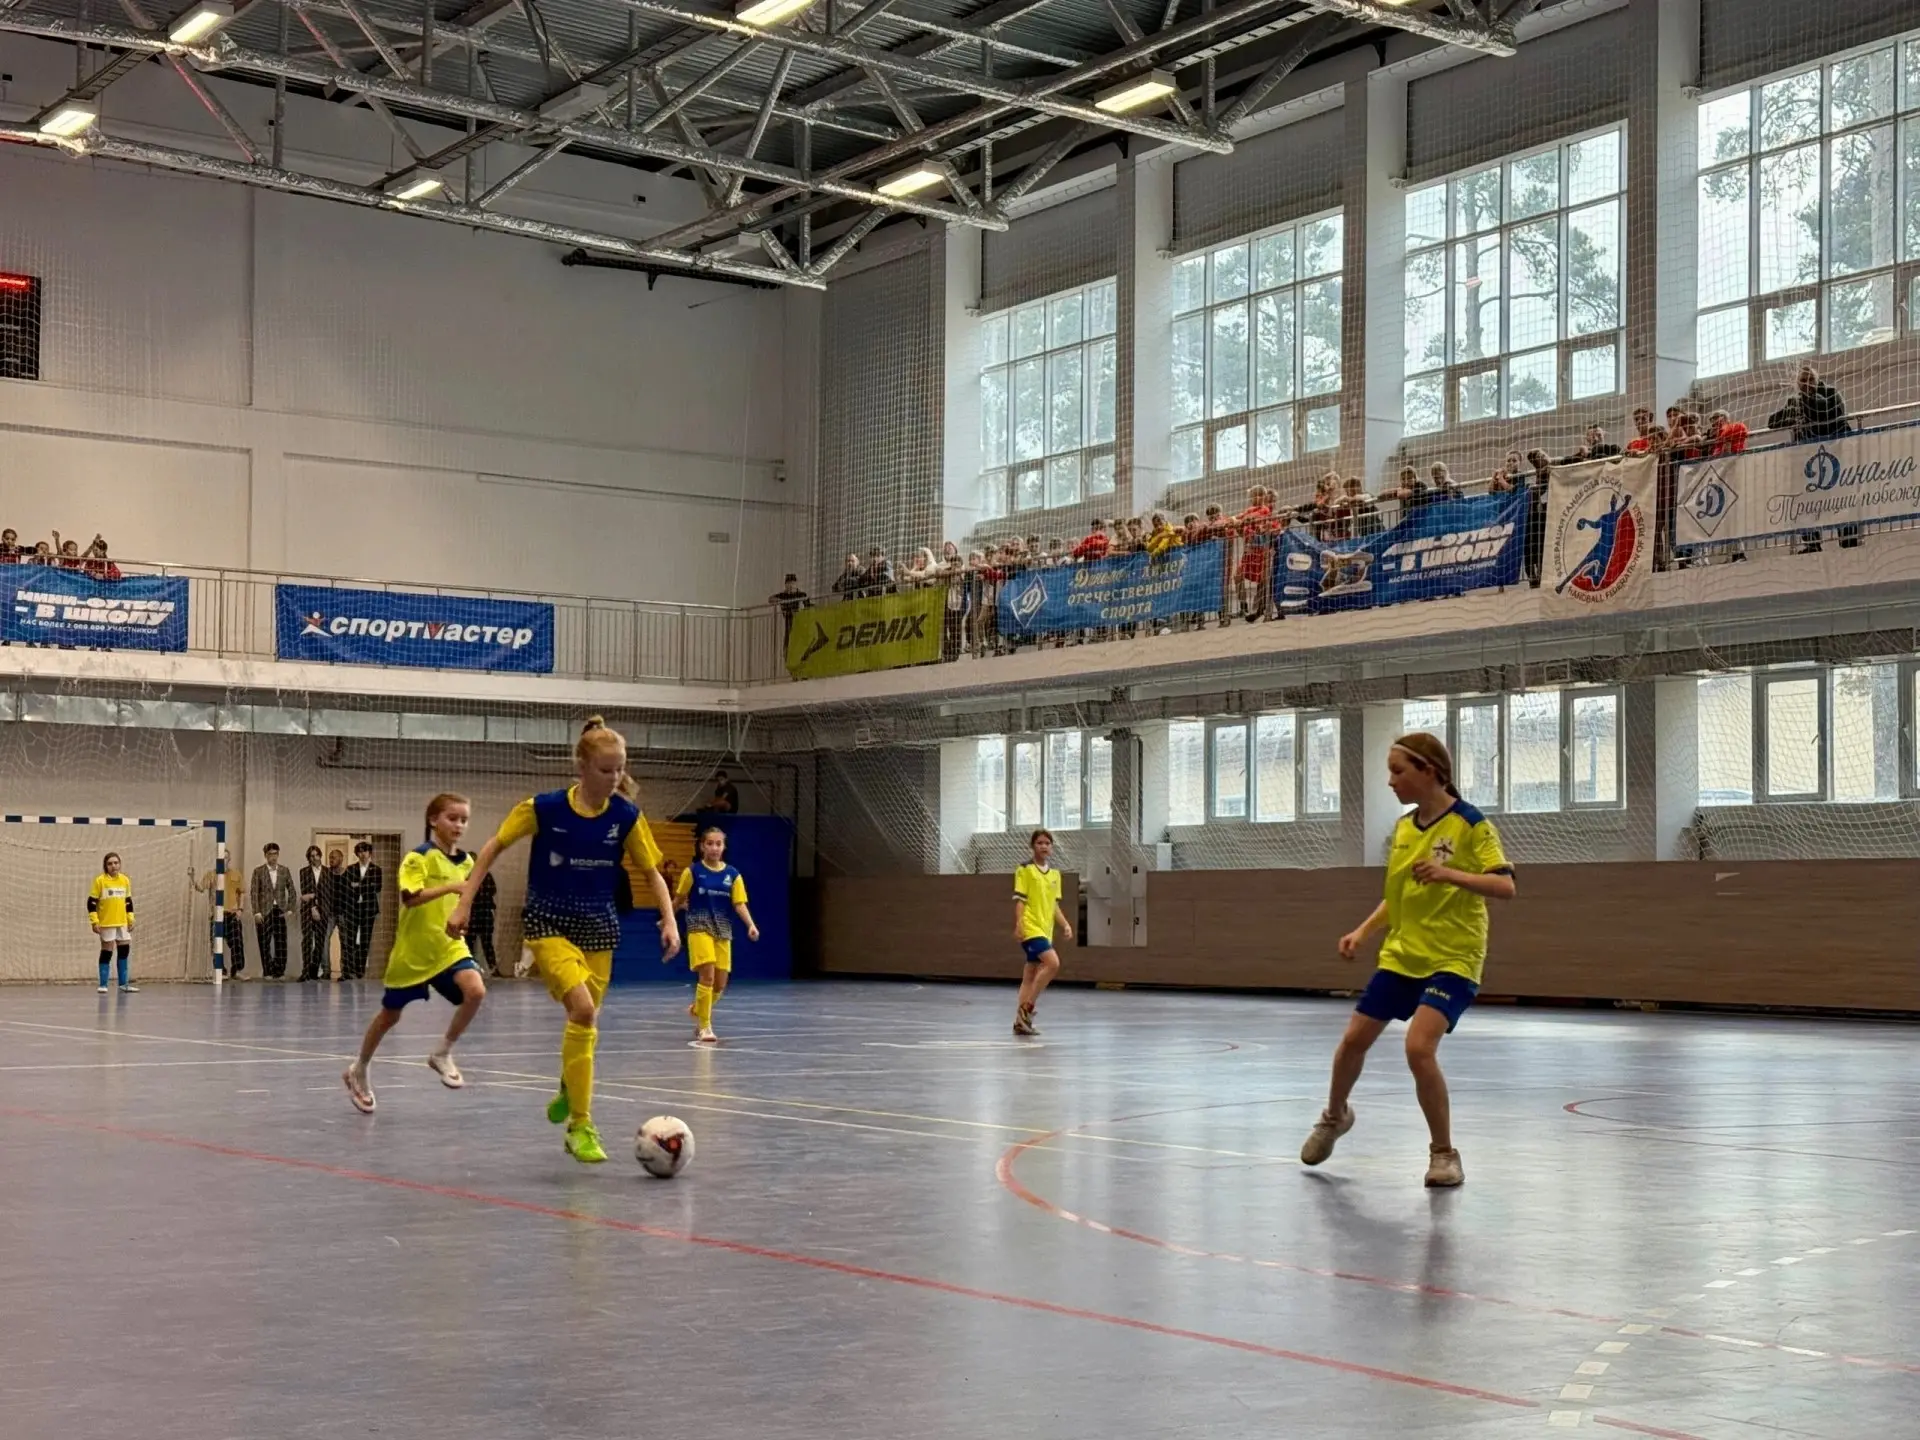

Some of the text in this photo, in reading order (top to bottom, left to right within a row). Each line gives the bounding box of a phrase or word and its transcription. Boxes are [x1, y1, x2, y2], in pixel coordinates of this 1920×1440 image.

[1804, 444, 1917, 493] Динамо
[1401, 554, 1416, 571] В
[1421, 537, 1509, 568] ШКОЛУ
[1568, 586, 1605, 604] HANDBALL
[35, 604, 56, 618] В
[63, 606, 171, 626] ШКОЛУ
[1100, 601, 1153, 621] спорта
[39, 620, 65, 629] БОЛЕЕ
[107, 624, 158, 634] УЧАСТНИКОВ
[330, 615, 533, 649] спортмастер
[836, 613, 928, 651] DEMIX
